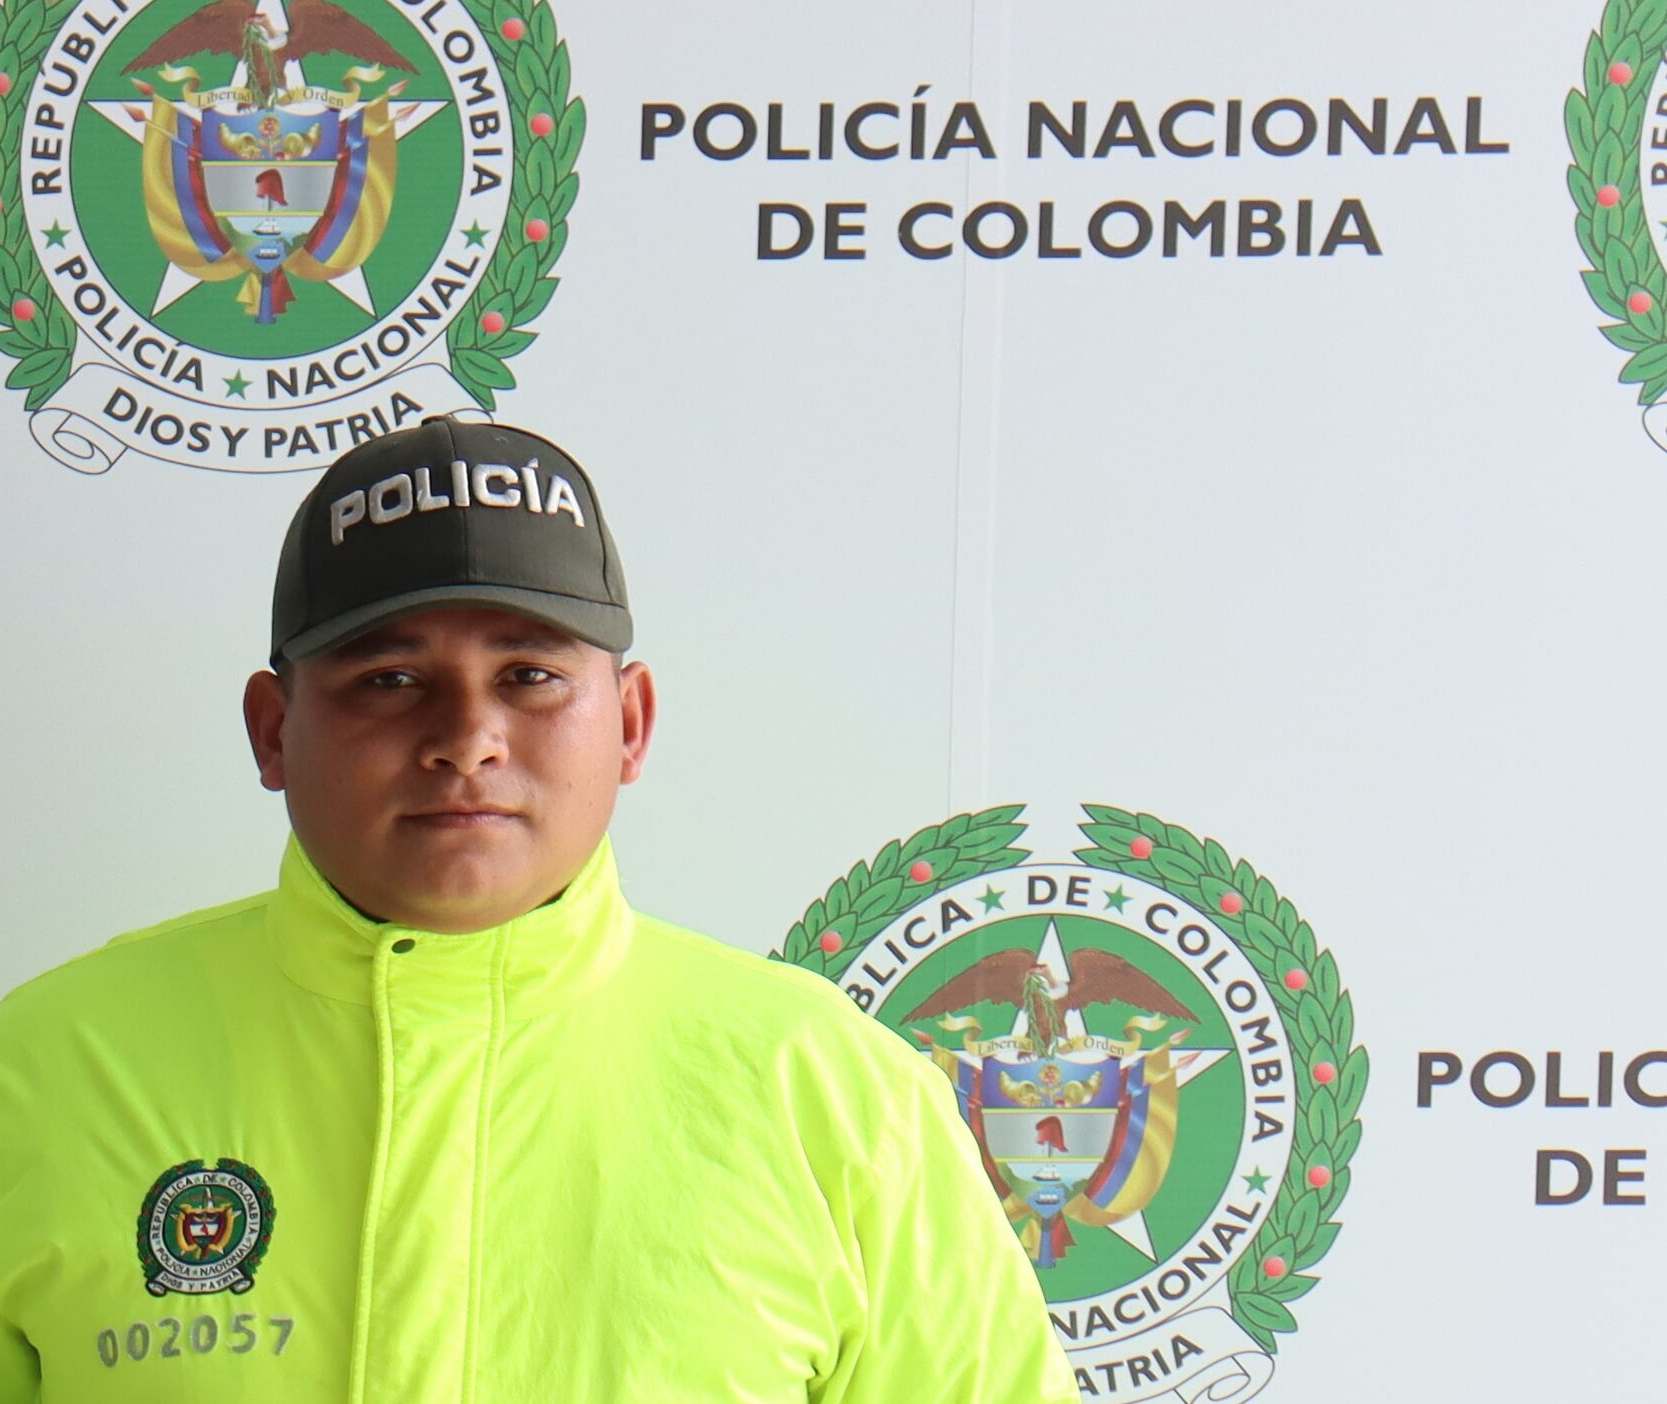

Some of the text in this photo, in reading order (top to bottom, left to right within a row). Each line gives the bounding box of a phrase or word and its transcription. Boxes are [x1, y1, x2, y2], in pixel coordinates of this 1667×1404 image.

[31, 0, 503, 196] REPÚBL LOMBIA
[641, 85, 1509, 161] POLICÍA NACIONAL
[757, 199, 1382, 260] DE COLOMBIA
[54, 254, 479, 399] POLICÍA NACIONAL
[265, 391, 424, 458] PATRIA
[330, 457, 585, 546] POLICÍA
[846, 874, 1285, 1144] BLICA DE COLOMBIA
[1417, 1050, 1667, 1108] POLIC
[1535, 1149, 1647, 1205] DE
[98, 1314, 295, 1368] 002057
[1075, 1334, 1204, 1396] ATRIA
